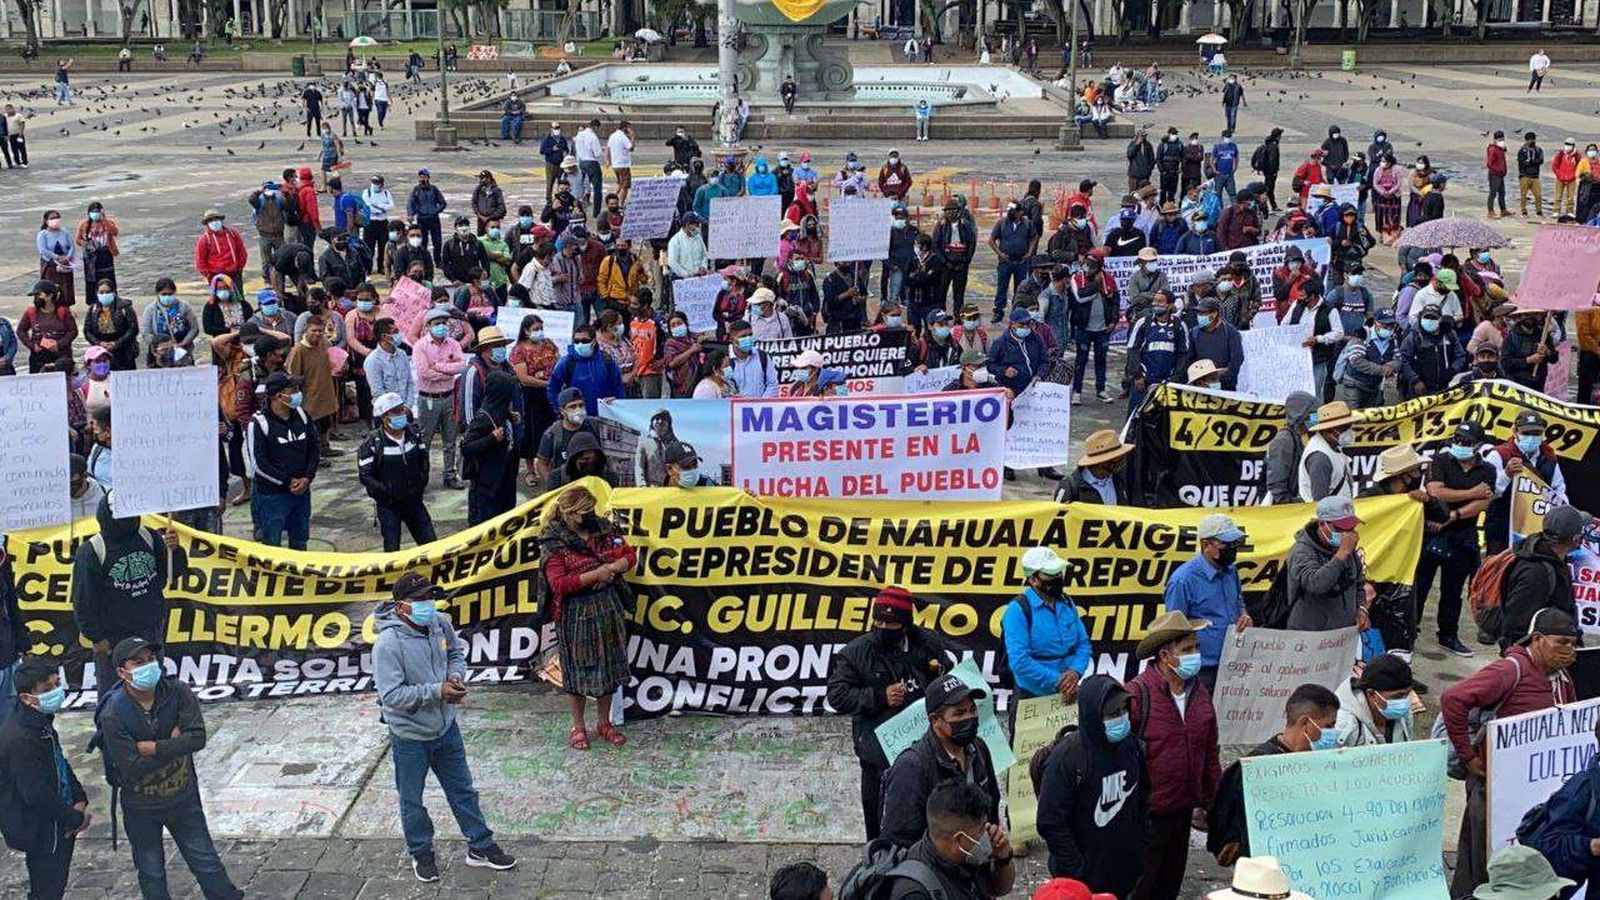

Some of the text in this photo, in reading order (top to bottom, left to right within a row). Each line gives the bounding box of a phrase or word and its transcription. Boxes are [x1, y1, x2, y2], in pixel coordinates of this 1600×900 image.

[802, 337, 822, 350] UN
[824, 333, 881, 349] PUEBLO
[823, 350, 849, 365] QUE
[853, 346, 907, 362] QUIERE
[1492, 381, 1522, 401] LA
[741, 396, 1001, 432] MAGISTERIO
[761, 431, 980, 463] PRESENTE EN LA
[1174, 415, 1250, 449] 4/90
[743, 466, 999, 499] LUCHA DEL PUEBLO
[660, 505, 808, 539] PUEBLO
[818, 516, 872, 546] DE
[878, 510, 1068, 548] NAHUALÁ
[1078, 519, 1198, 552] EXIGE
[190, 537, 239, 563] DE
[634, 545, 935, 586] ICEPRESIDENTE
[942, 556, 992, 586] DE
